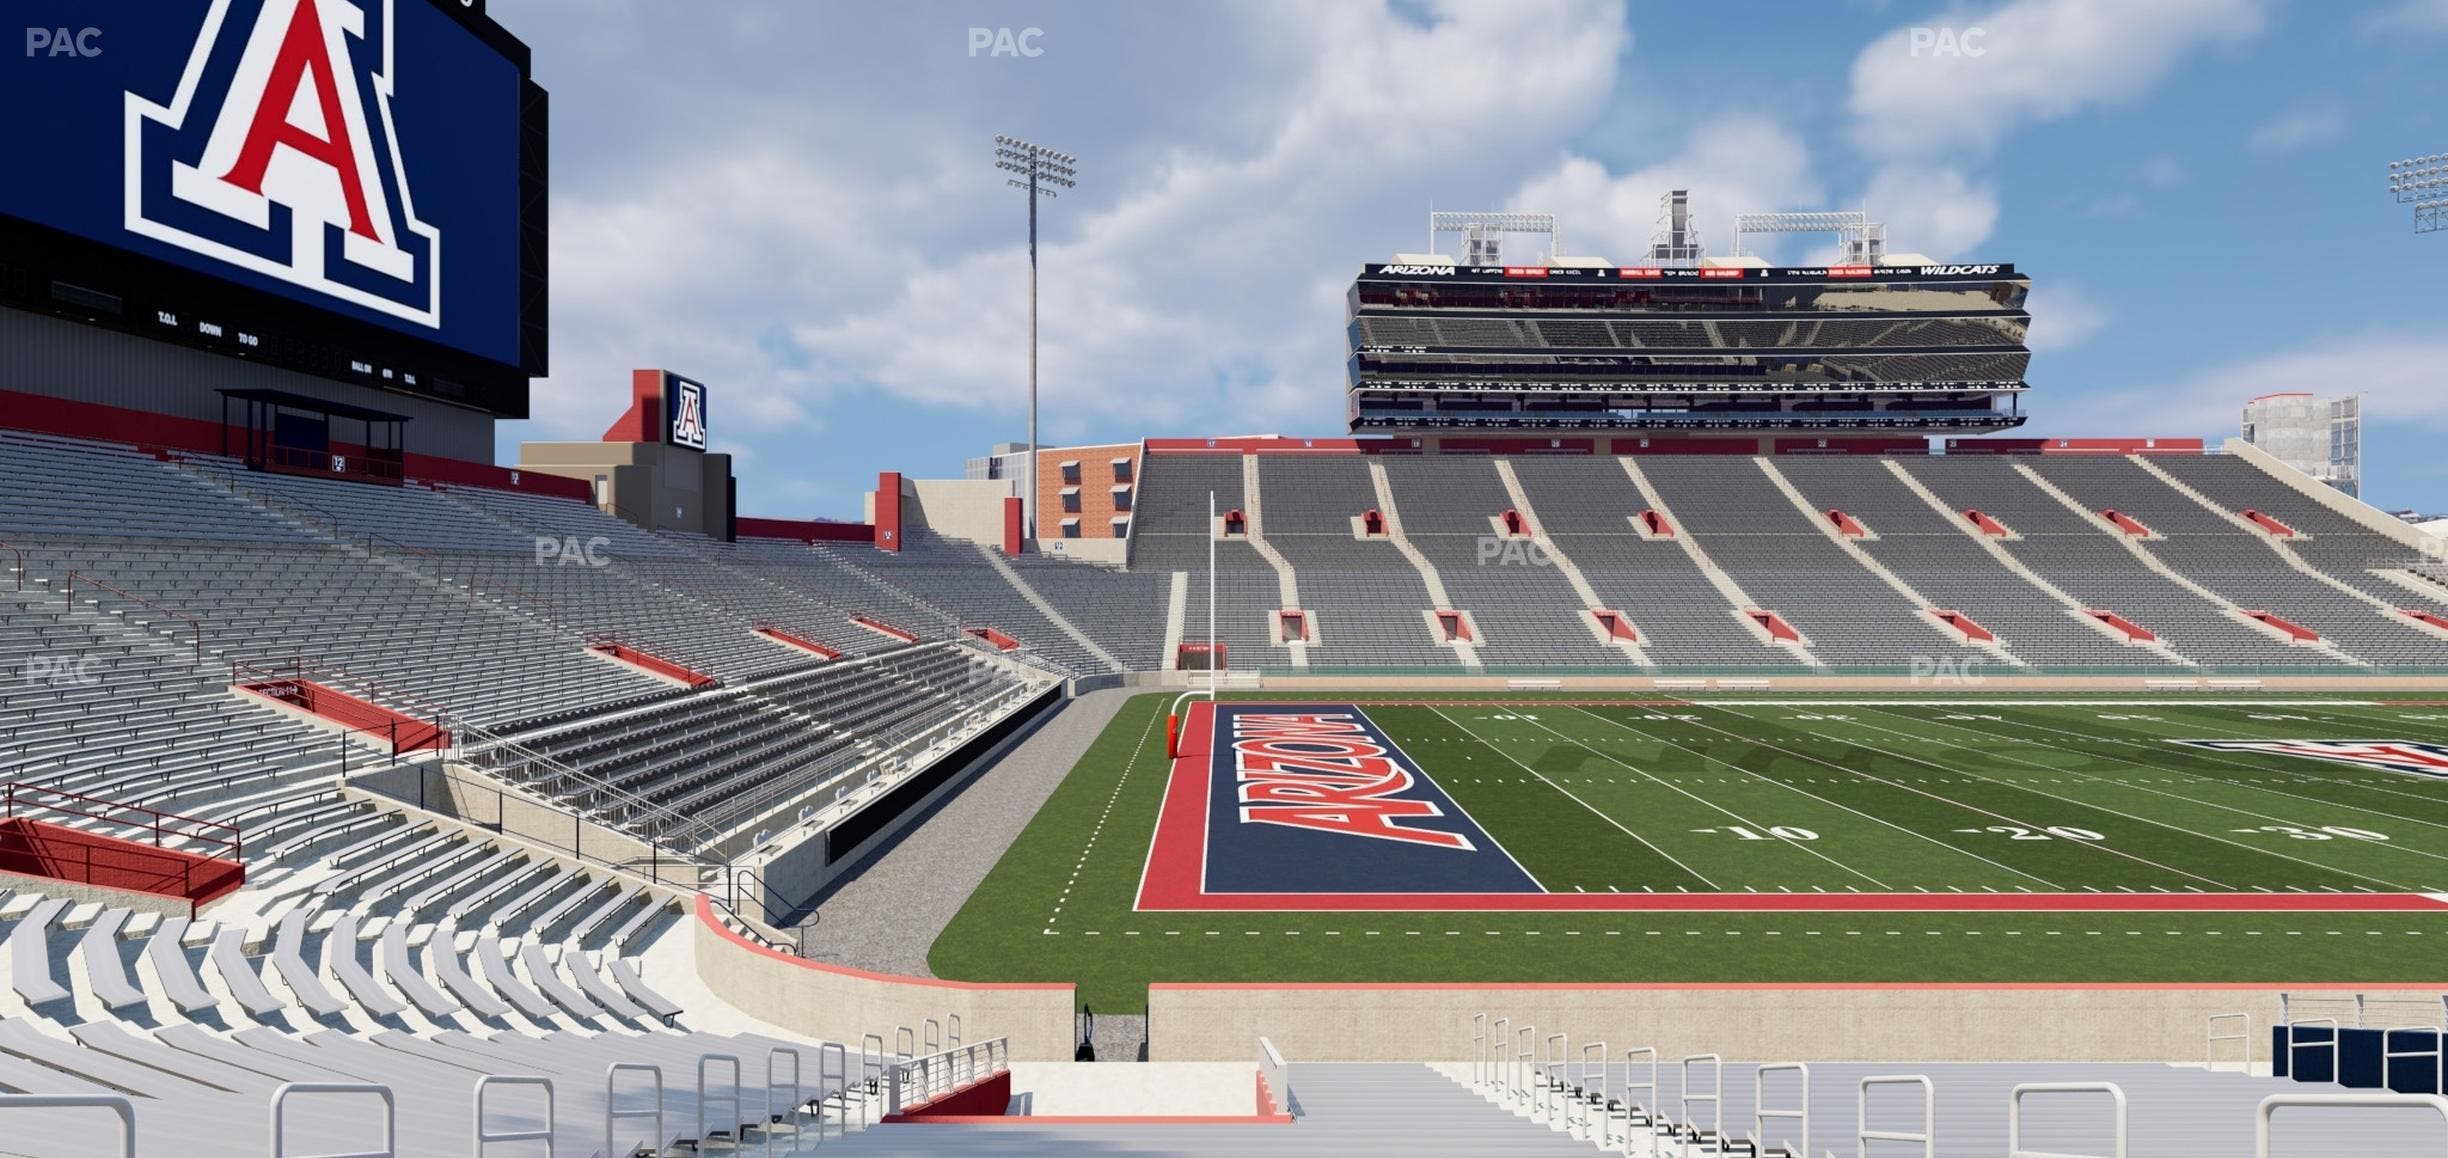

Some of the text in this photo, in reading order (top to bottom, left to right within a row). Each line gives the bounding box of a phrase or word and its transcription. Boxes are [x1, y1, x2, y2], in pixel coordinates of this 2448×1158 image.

[1379, 264, 1456, 276] ARIZONA
[1921, 264, 2000, 275] WILDCATS
[199, 322, 222, 337] DOWN
[673, 380, 706, 450] A
[1232, 713, 1479, 851] ARIZONA
[1716, 825, 1821, 841] 10
[1986, 825, 2106, 841] 20
[2258, 825, 2390, 841] 30
